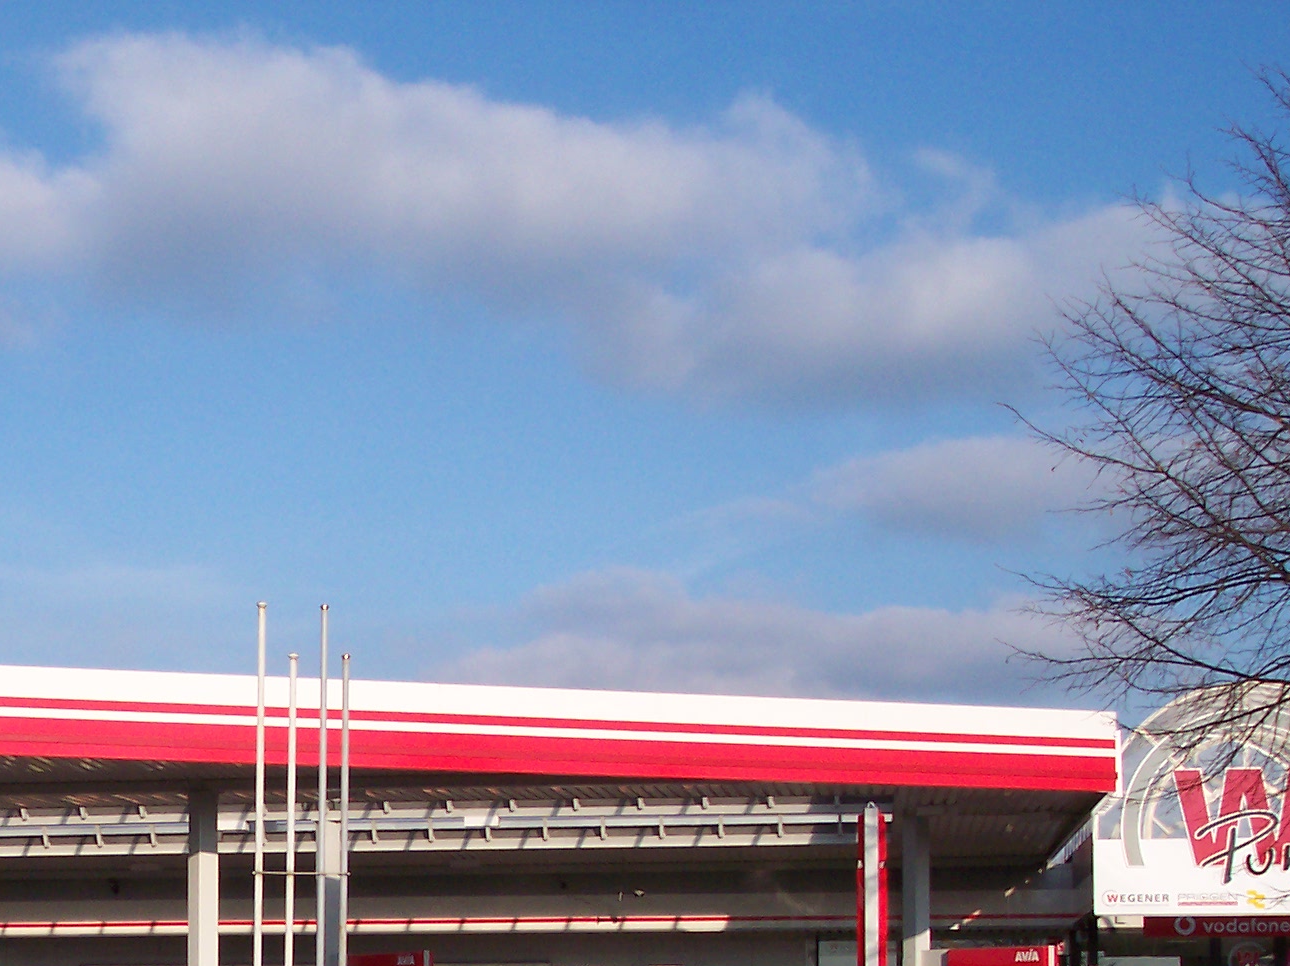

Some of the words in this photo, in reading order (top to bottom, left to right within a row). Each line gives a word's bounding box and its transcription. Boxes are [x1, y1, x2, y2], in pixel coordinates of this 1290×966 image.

[1106, 893, 1170, 903] WEGENER
[1203, 918, 1290, 933] vodafone
[1014, 949, 1040, 962] AVIA
